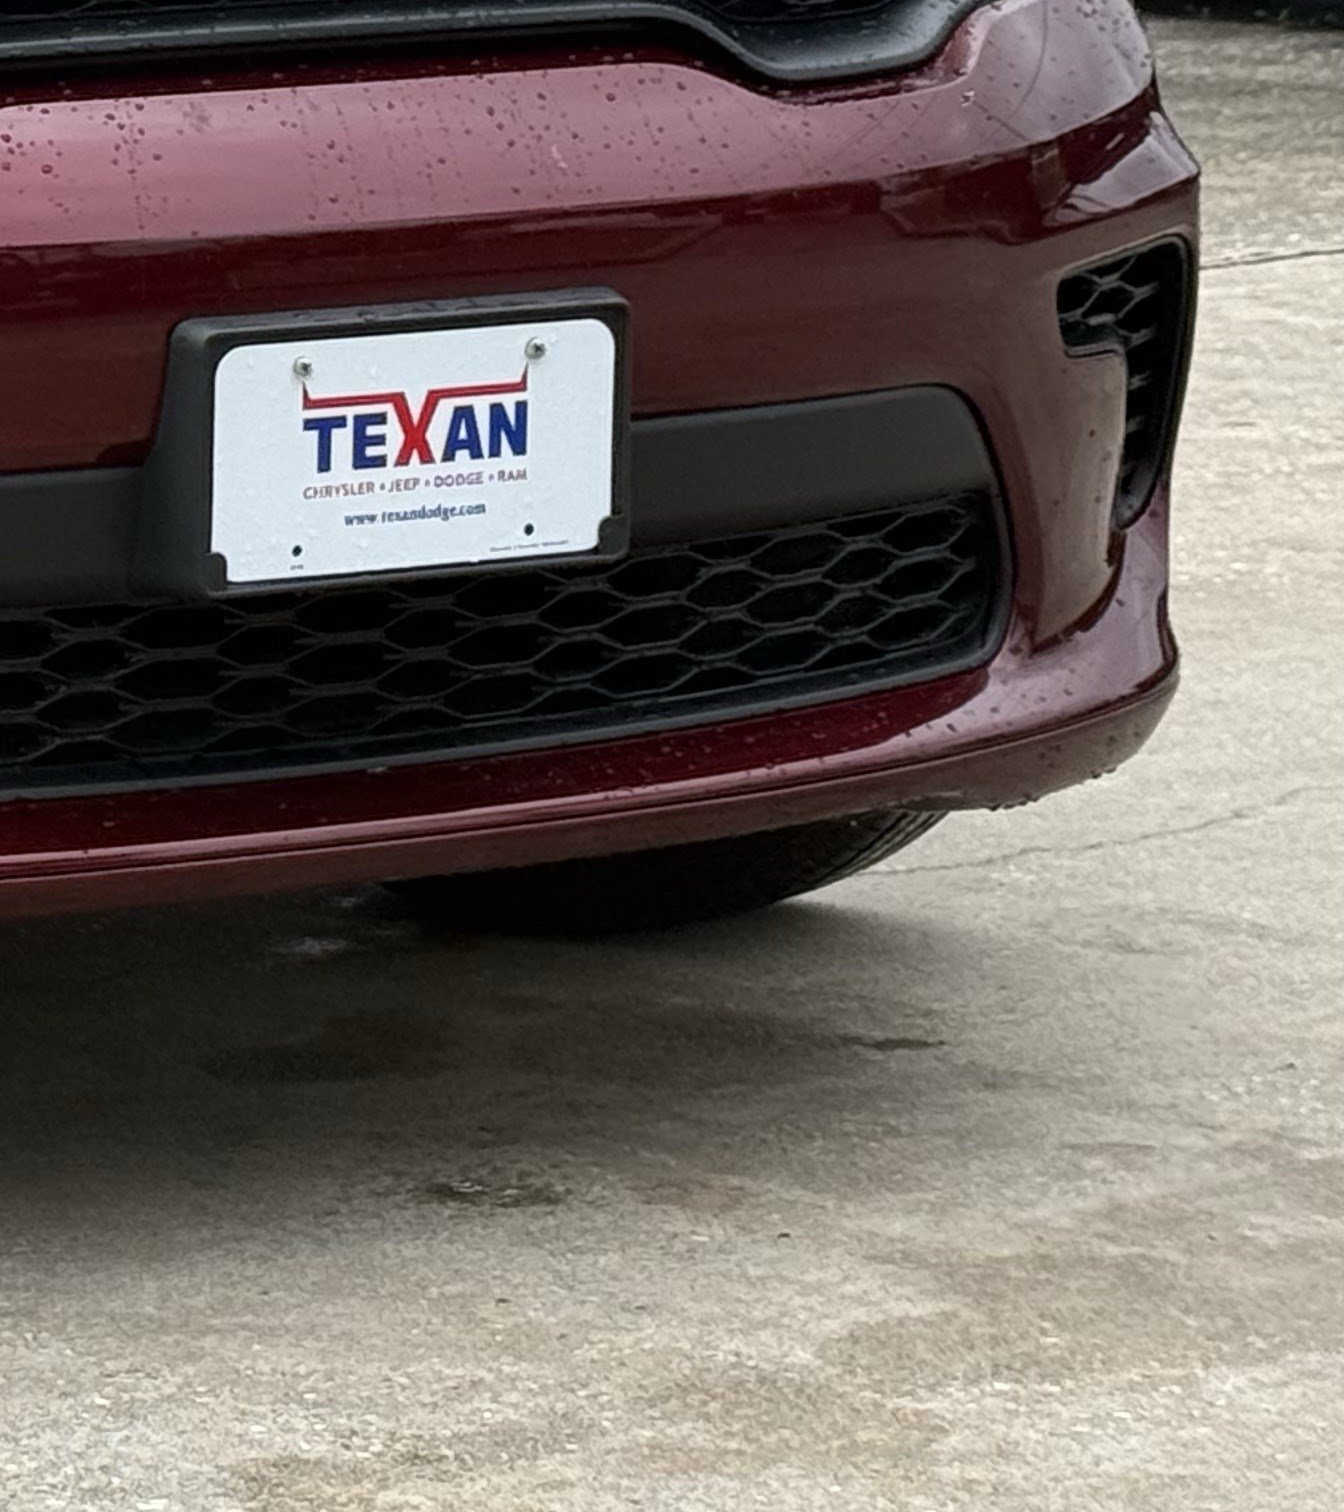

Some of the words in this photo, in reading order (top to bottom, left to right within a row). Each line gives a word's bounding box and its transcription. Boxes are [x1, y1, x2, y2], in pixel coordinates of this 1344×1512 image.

[302, 376, 529, 473] TEXAN
[302, 480, 376, 501] CHRYSLER
[387, 477, 421, 494] JEEP
[432, 471, 485, 489] DODGE
[496, 467, 529, 484] RAM
